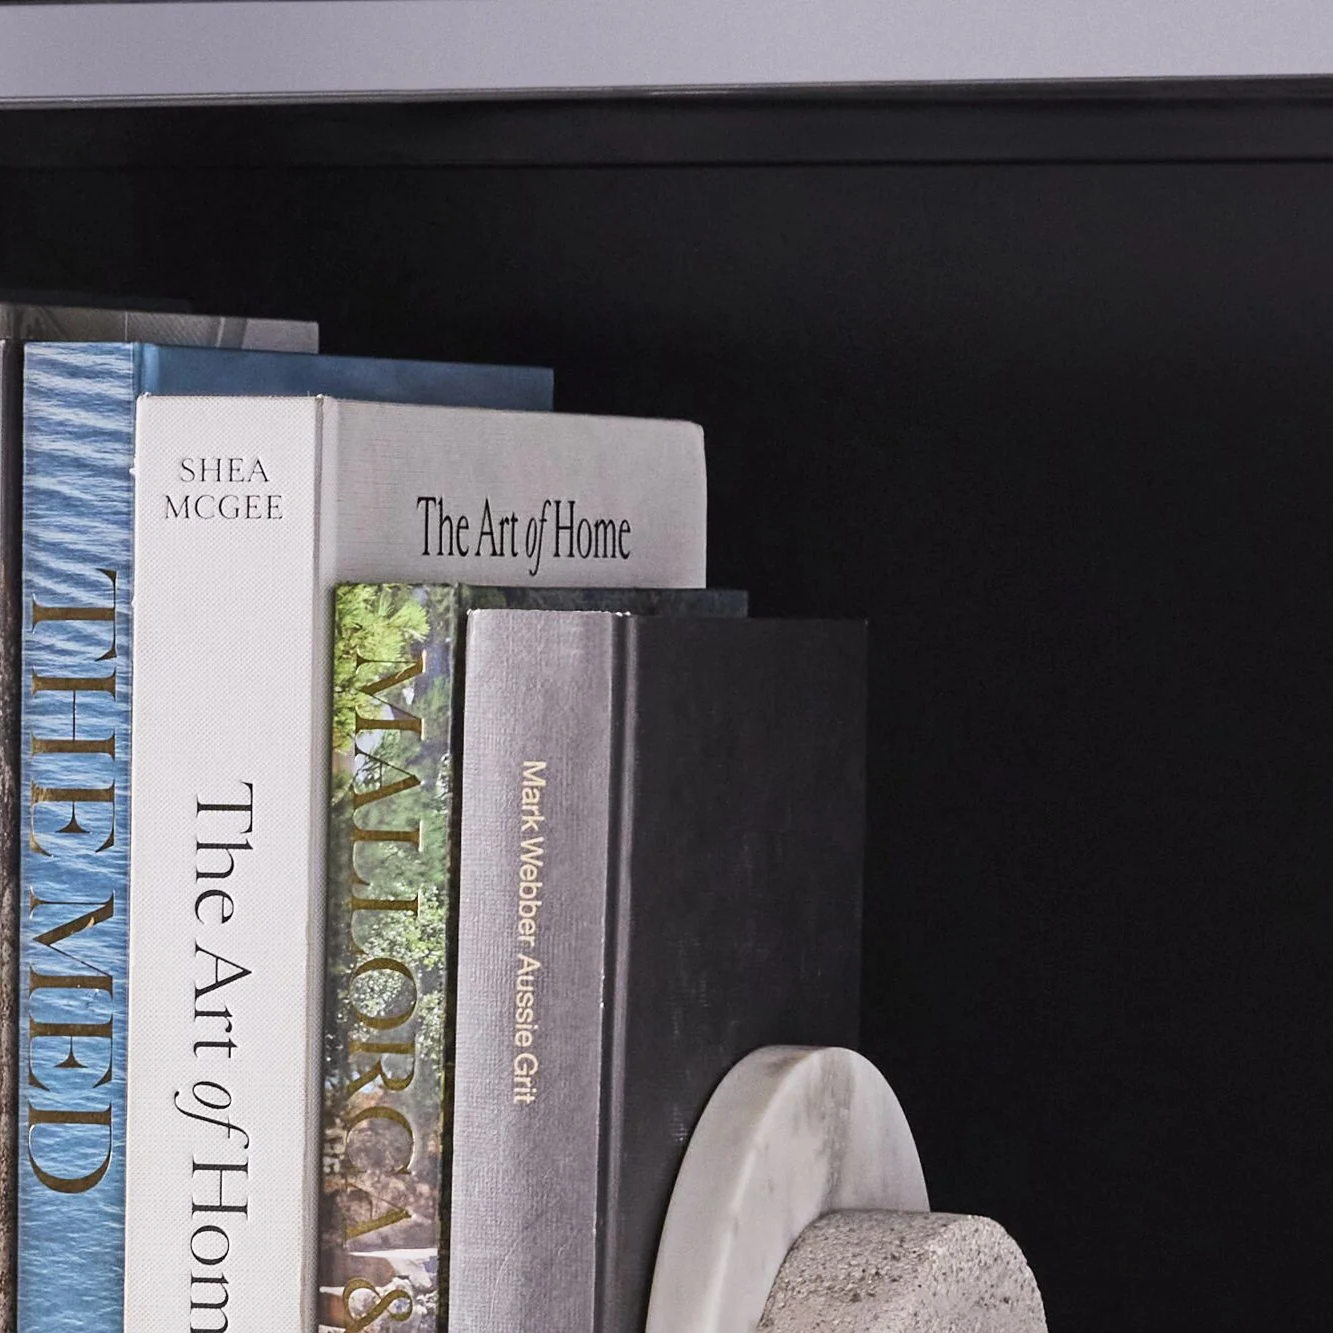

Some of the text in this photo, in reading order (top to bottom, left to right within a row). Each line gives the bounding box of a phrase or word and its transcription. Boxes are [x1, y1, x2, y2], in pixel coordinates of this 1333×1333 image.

[165, 494, 283, 520] MCGEE
[179, 458, 269, 484] SHEA
[416, 496, 632, 576] The Art of Home
[28, 567, 119, 1194] THE MED
[193, 781, 254, 926] The
[344, 648, 427, 1242] MALLORCA
[512, 761, 548, 1105] Mark Webber Aussie Grit
[193, 942, 252, 1059] Art
[174, 1080, 250, 1150] of
